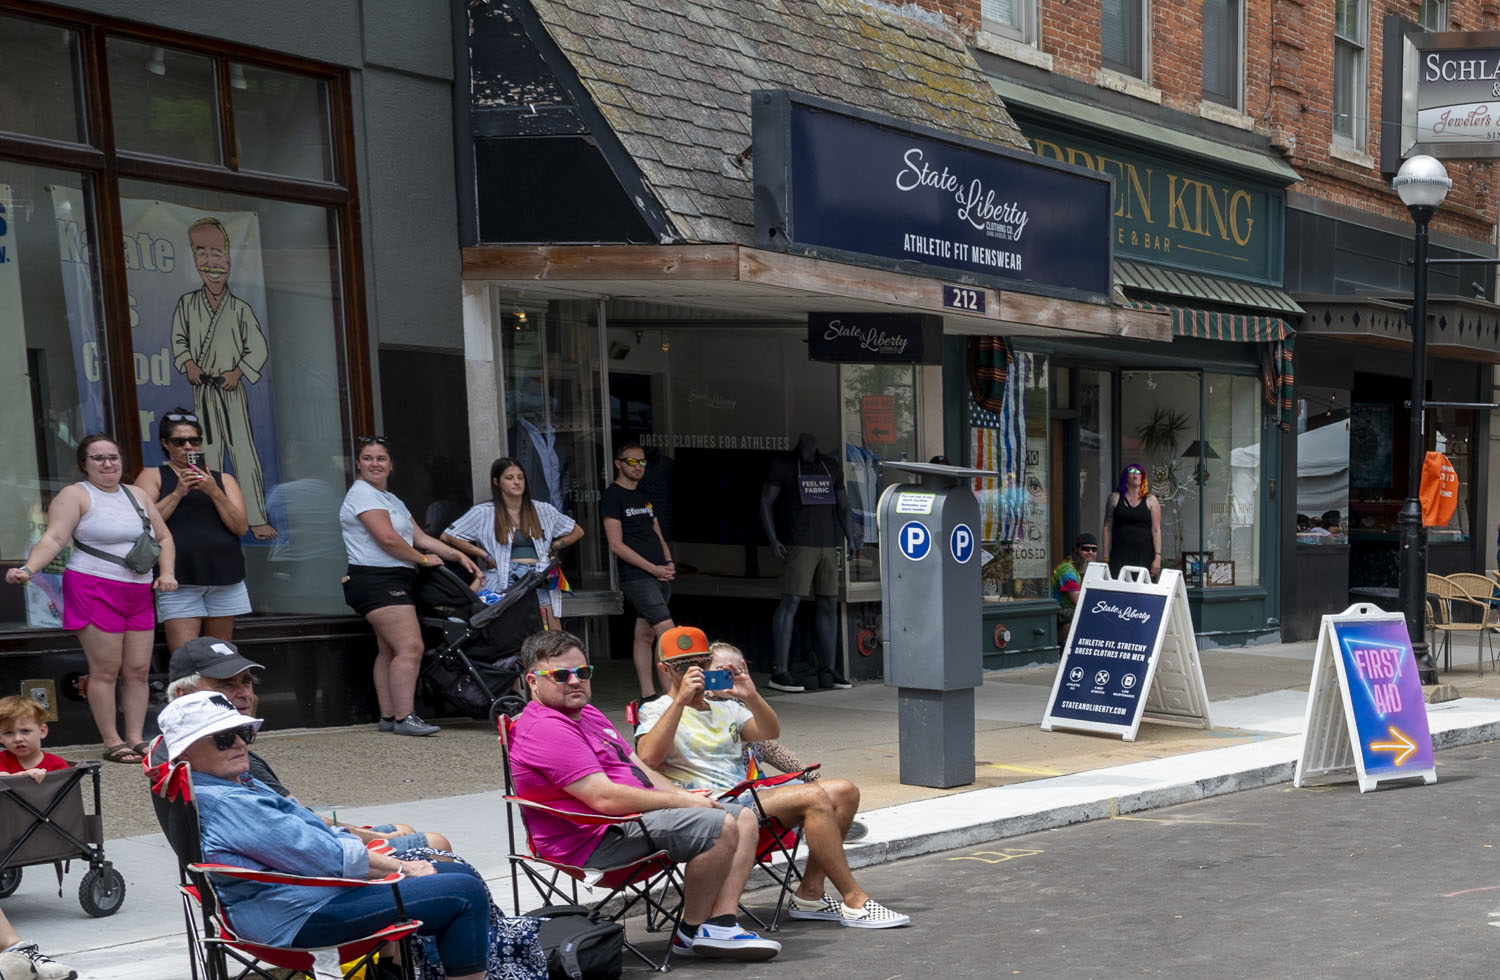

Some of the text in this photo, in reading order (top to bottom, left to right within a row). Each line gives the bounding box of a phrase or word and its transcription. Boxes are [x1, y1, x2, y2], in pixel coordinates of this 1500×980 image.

[1433, 105, 1491, 134] Jewelers
[896, 148, 958, 191] State
[955, 184, 967, 205] &
[957, 178, 1029, 241] Liberty
[1166, 173, 1255, 247] KING
[904, 233, 1022, 271] ATHLETIC FIT MENSWEAR
[1131, 231, 1139, 246] &
[1144, 233, 1171, 252] BAR
[952, 288, 978, 310] 212
[824, 319, 861, 341] State
[861, 327, 908, 354] Liberty
[639, 434, 790, 450] DRESS CLOTHES FOR ATHLETES
[907, 527, 925, 553] P
[957, 530, 969, 557] P
[1092, 600, 1118, 613] State
[1118, 606, 1151, 624] Liberty
[1074, 646, 1145, 662] DRESS CLOTHES FOR MEN
[1078, 638, 1105, 648] ATHLETIC
[1117, 642, 1147, 652] STRETCHY
[1354, 649, 1403, 680] FIRST
[1373, 683, 1402, 713] AID
